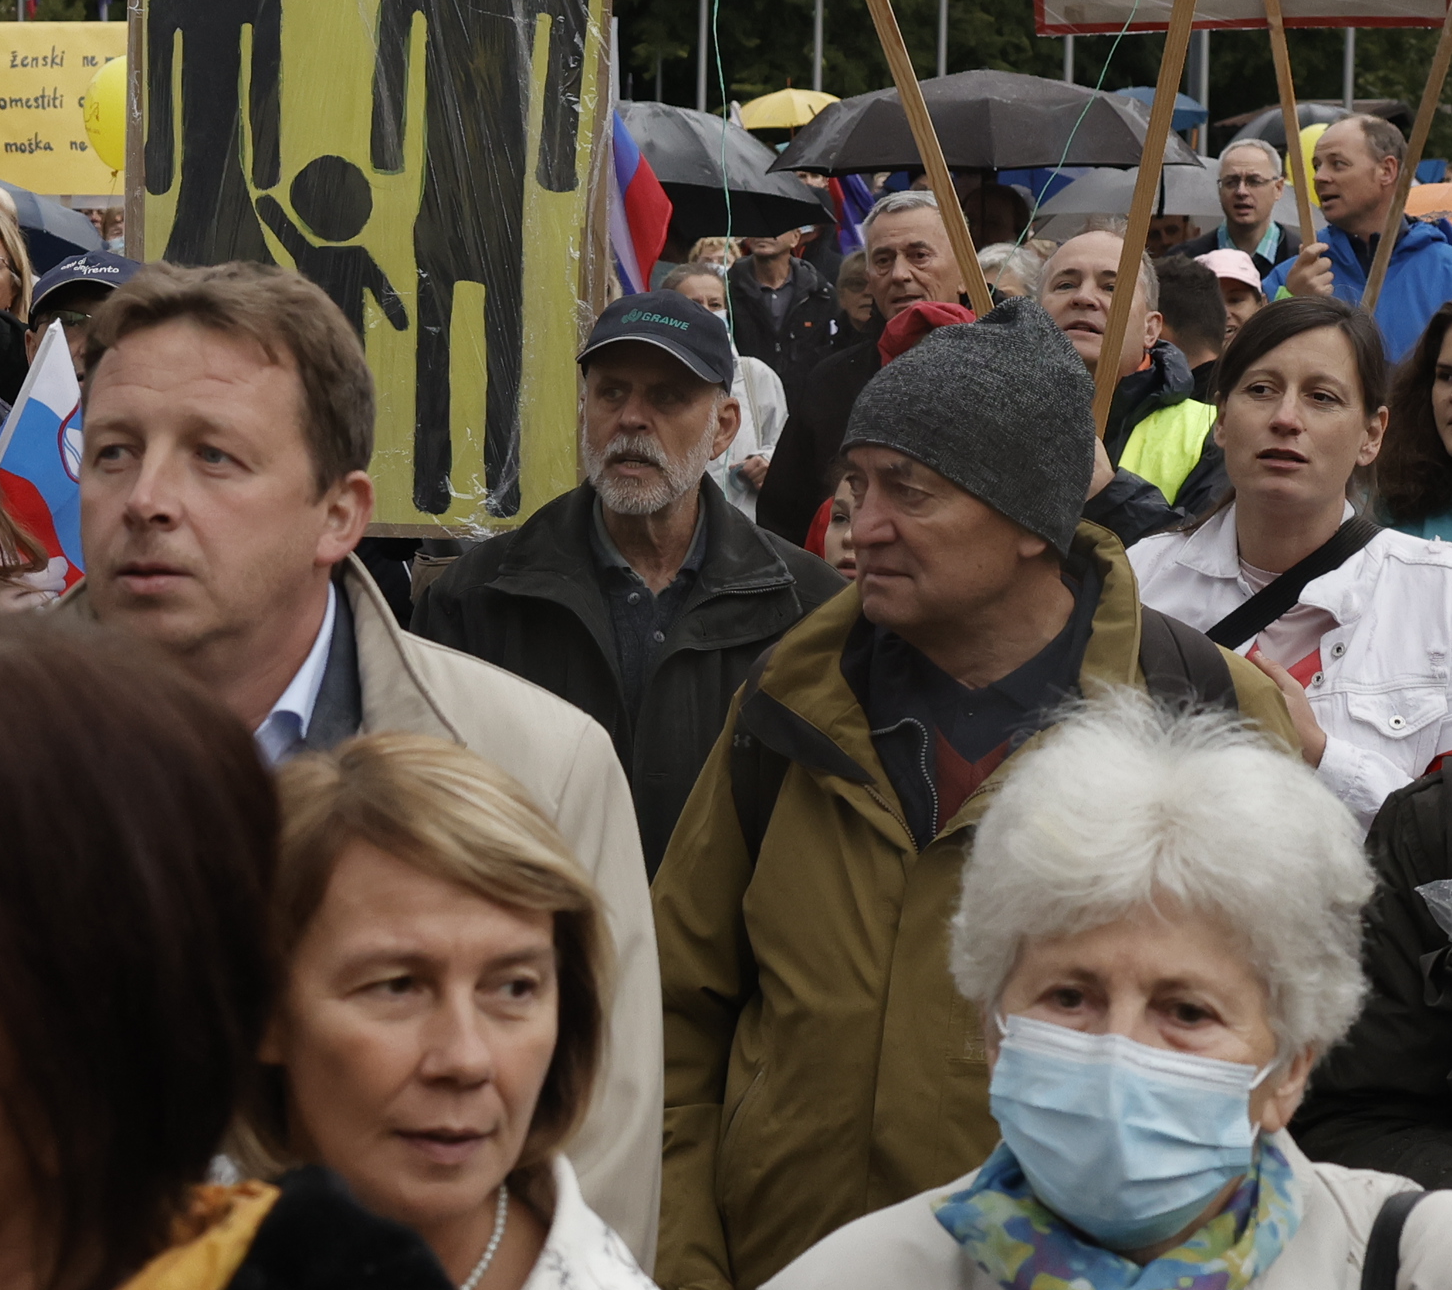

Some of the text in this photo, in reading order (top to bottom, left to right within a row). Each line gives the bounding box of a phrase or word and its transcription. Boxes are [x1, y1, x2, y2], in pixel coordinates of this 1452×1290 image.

[10, 45, 65, 68] ženski
[82, 54, 98, 68] ne
[4, 132, 54, 155] moška
[70, 140, 88, 152] ne
[641, 312, 690, 330] GRAWE
